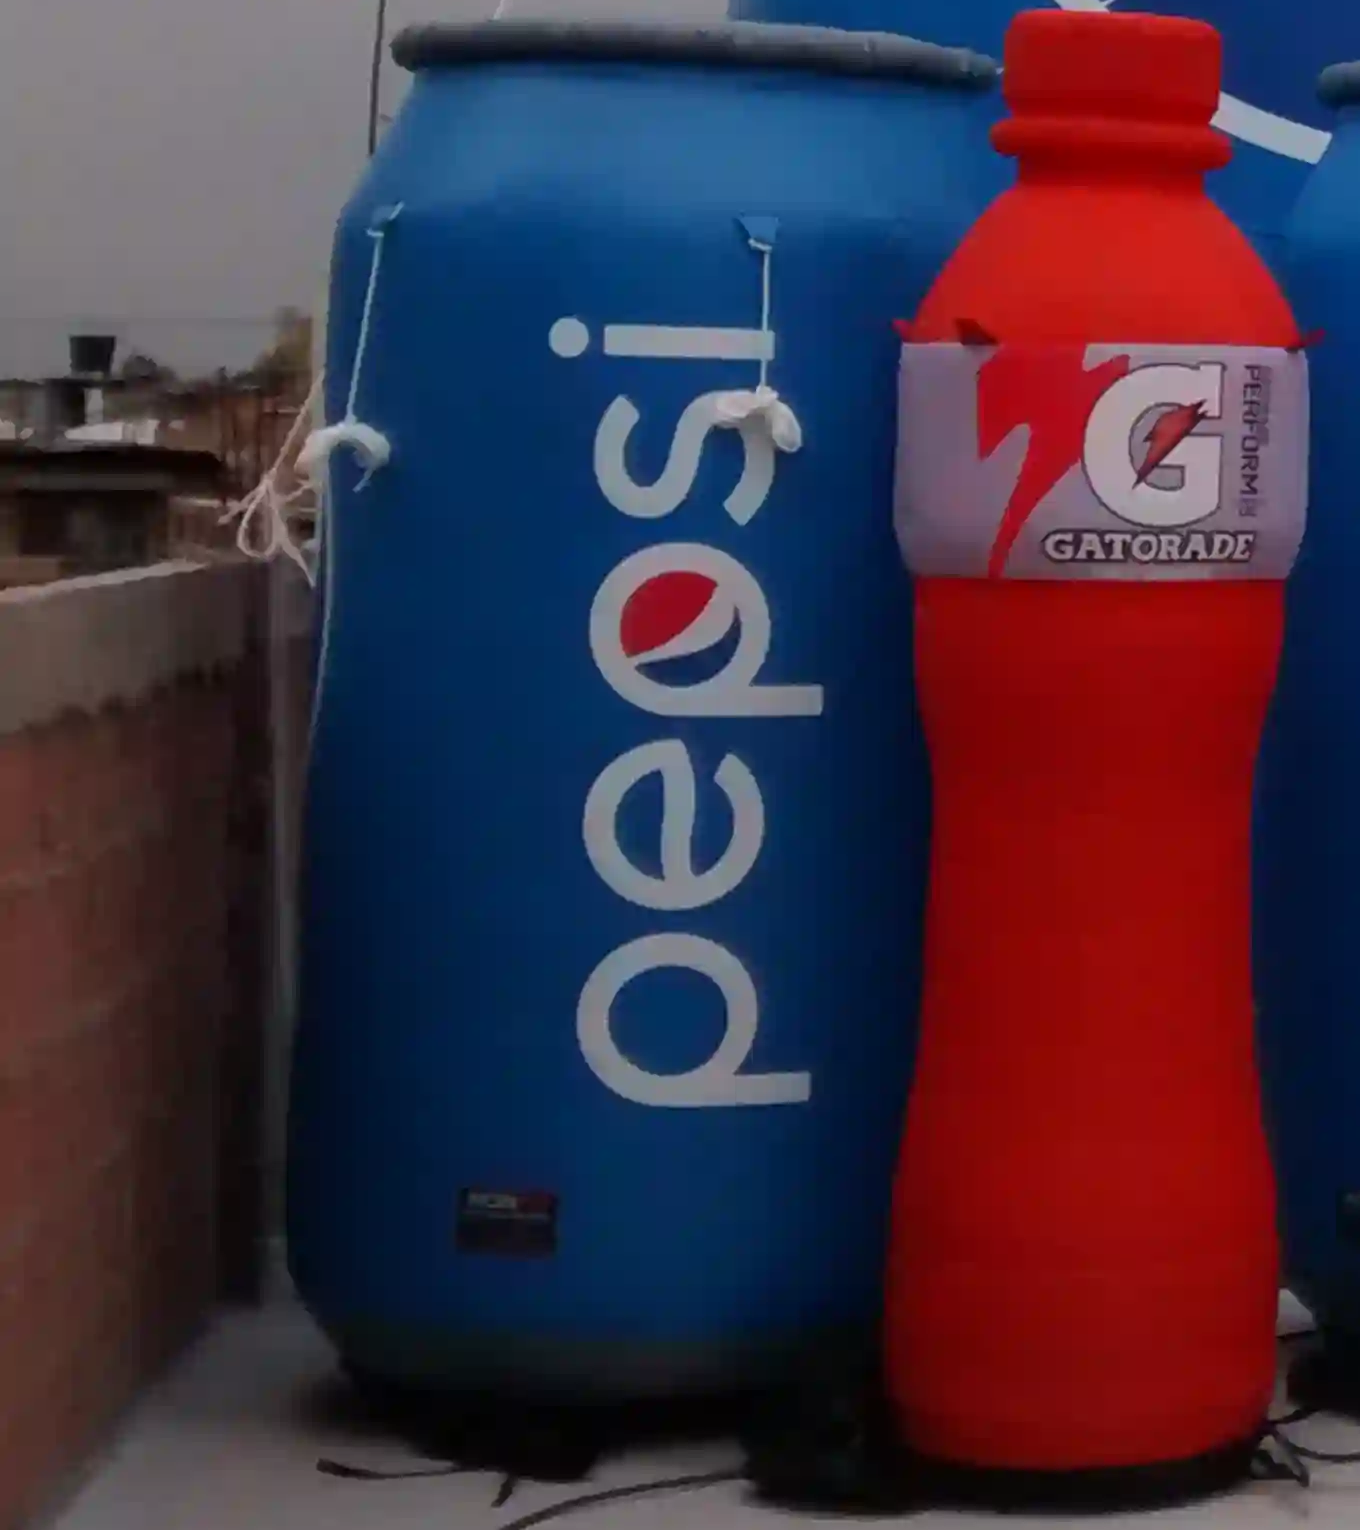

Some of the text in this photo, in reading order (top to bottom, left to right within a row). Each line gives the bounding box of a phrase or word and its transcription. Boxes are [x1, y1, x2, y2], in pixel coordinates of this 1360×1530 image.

[1082, 361, 1227, 528] G
[1239, 363, 1262, 496] PERFORM
[1042, 528, 1260, 564] GATORADE
[547, 315, 824, 1108] pepsi
